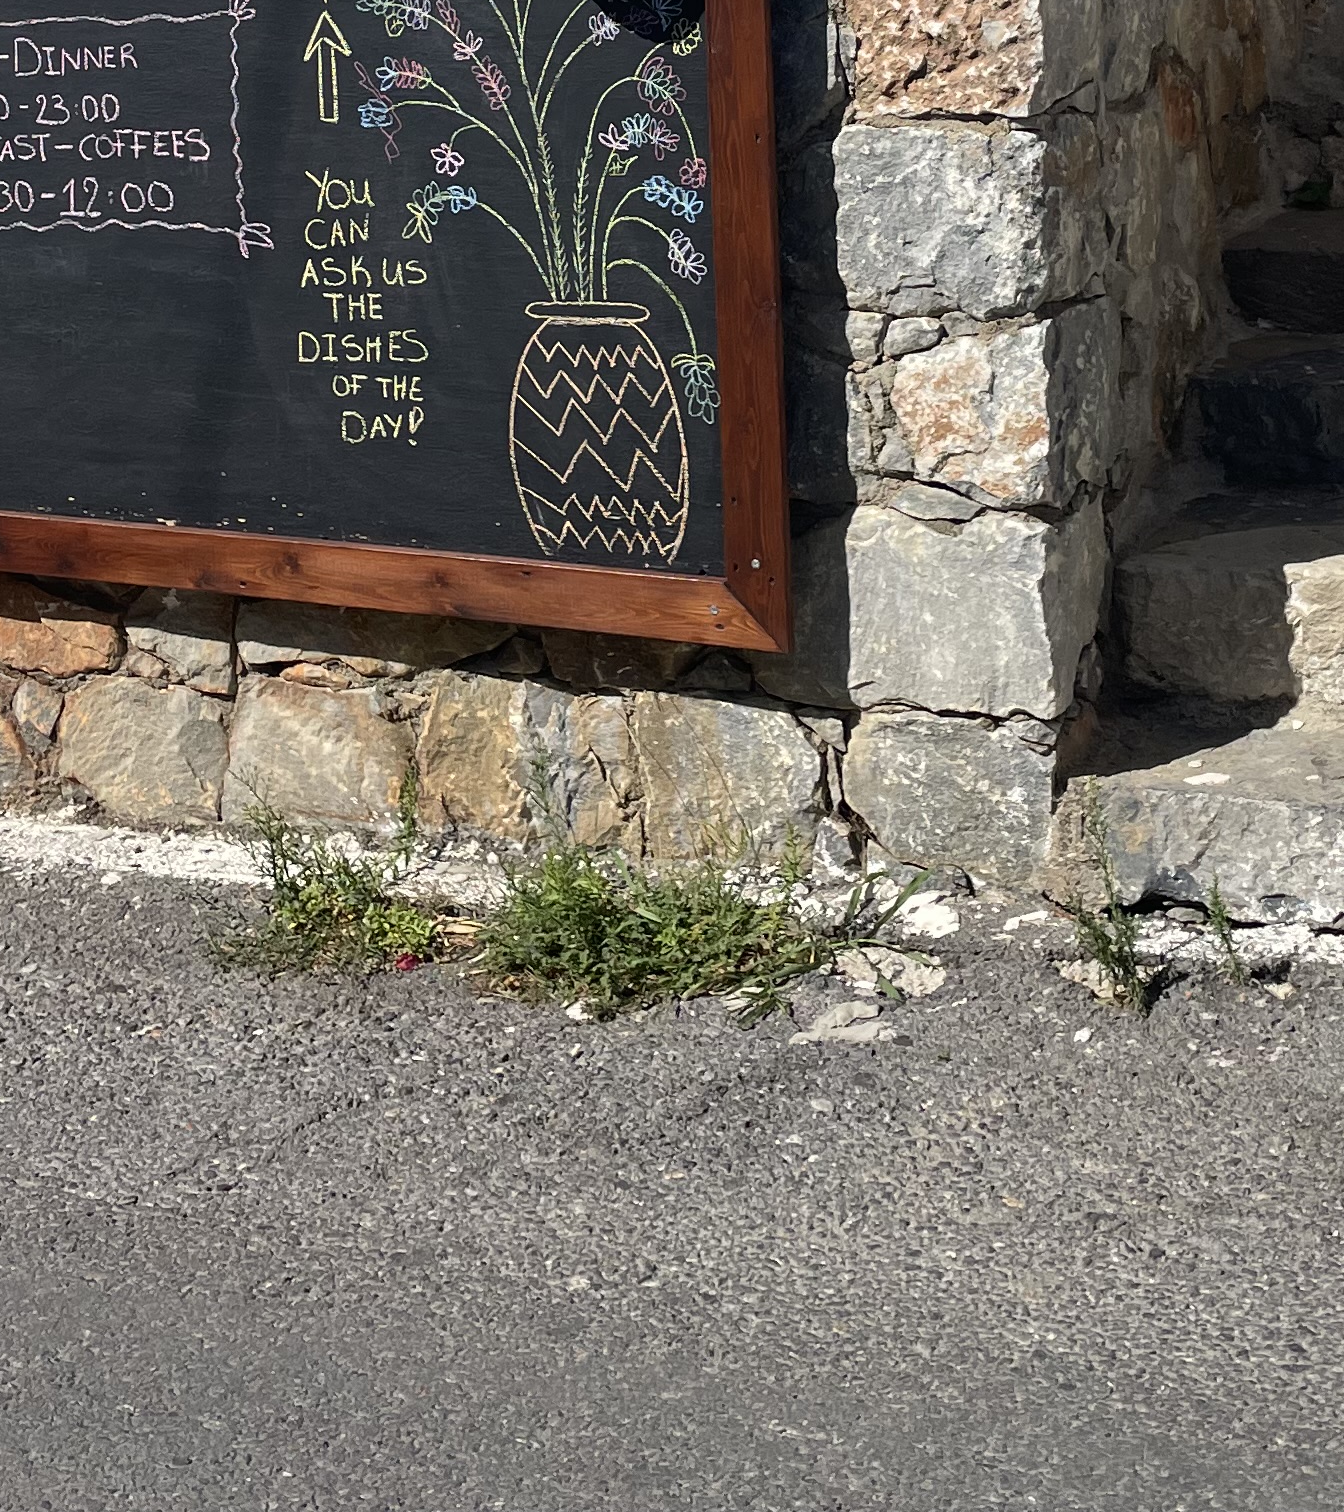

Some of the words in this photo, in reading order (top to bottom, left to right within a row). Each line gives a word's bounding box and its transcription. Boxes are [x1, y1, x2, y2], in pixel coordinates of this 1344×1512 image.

[305, 167, 375, 212] YOU
[304, 213, 370, 250] CAN
[301, 255, 372, 287] ASK
[381, 258, 428, 287] US
[322, 293, 384, 322] THE
[298, 329, 429, 363] DISHES
[332, 374, 368, 397] OF
[375, 376, 424, 402] THE
[341, 406, 425, 446] DAY!
